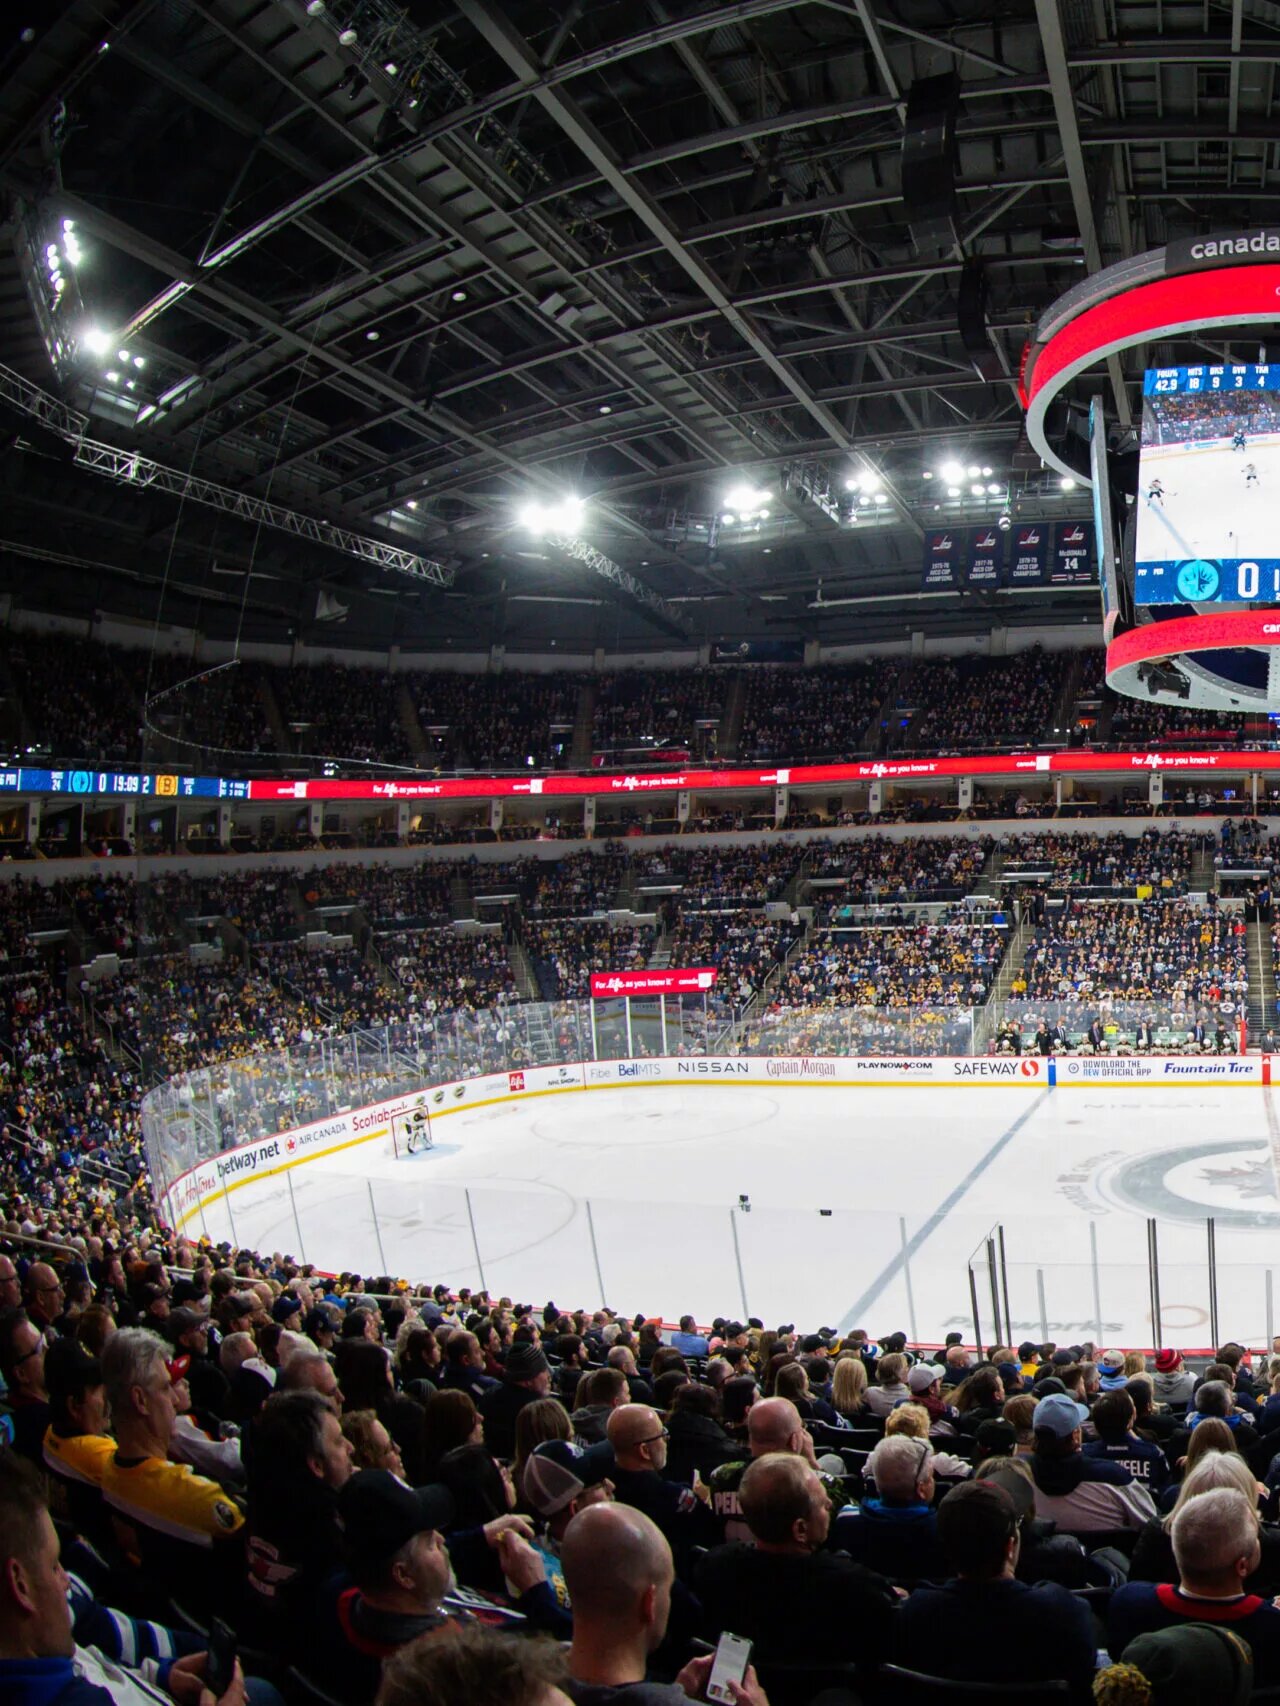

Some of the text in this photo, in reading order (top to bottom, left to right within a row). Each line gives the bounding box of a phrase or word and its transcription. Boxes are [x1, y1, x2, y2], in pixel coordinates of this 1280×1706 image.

[1191, 232, 1280, 259] canada
[1155, 379, 1177, 391] 42.9
[1189, 378, 1200, 388] 18
[1212, 376, 1220, 388] 9
[1235, 376, 1243, 387] 3
[1258, 376, 1265, 387] 4
[1059, 549, 1087, 557] McDONALD
[1029, 563, 1039, 571] CUP
[1064, 557, 1079, 570] 14
[1237, 562, 1259, 598] 0
[1143, 754, 1164, 768] life
[871, 764, 889, 777] life
[898, 767, 910, 775] you
[52, 780, 61, 791] 24
[99, 773, 149, 794] 0 19:09 2
[185, 785, 193, 795] 15
[606, 977, 625, 992] life
[634, 981, 647, 989] you
[619, 1063, 661, 1076] Bell MTS
[678, 1062, 749, 1073] NISSAN
[766, 1058, 835, 1077] Captain Morgan
[954, 1062, 1018, 1075] SAFEWAY
[1083, 1060, 1124, 1068] DOWNLOAD
[1164, 1062, 1253, 1074] Fountain Tire
[1083, 1069, 1151, 1077] NEW OFFICIAL APP
[299, 1122, 348, 1146] AIR CANADA
[217, 1141, 280, 1178] betway.net
